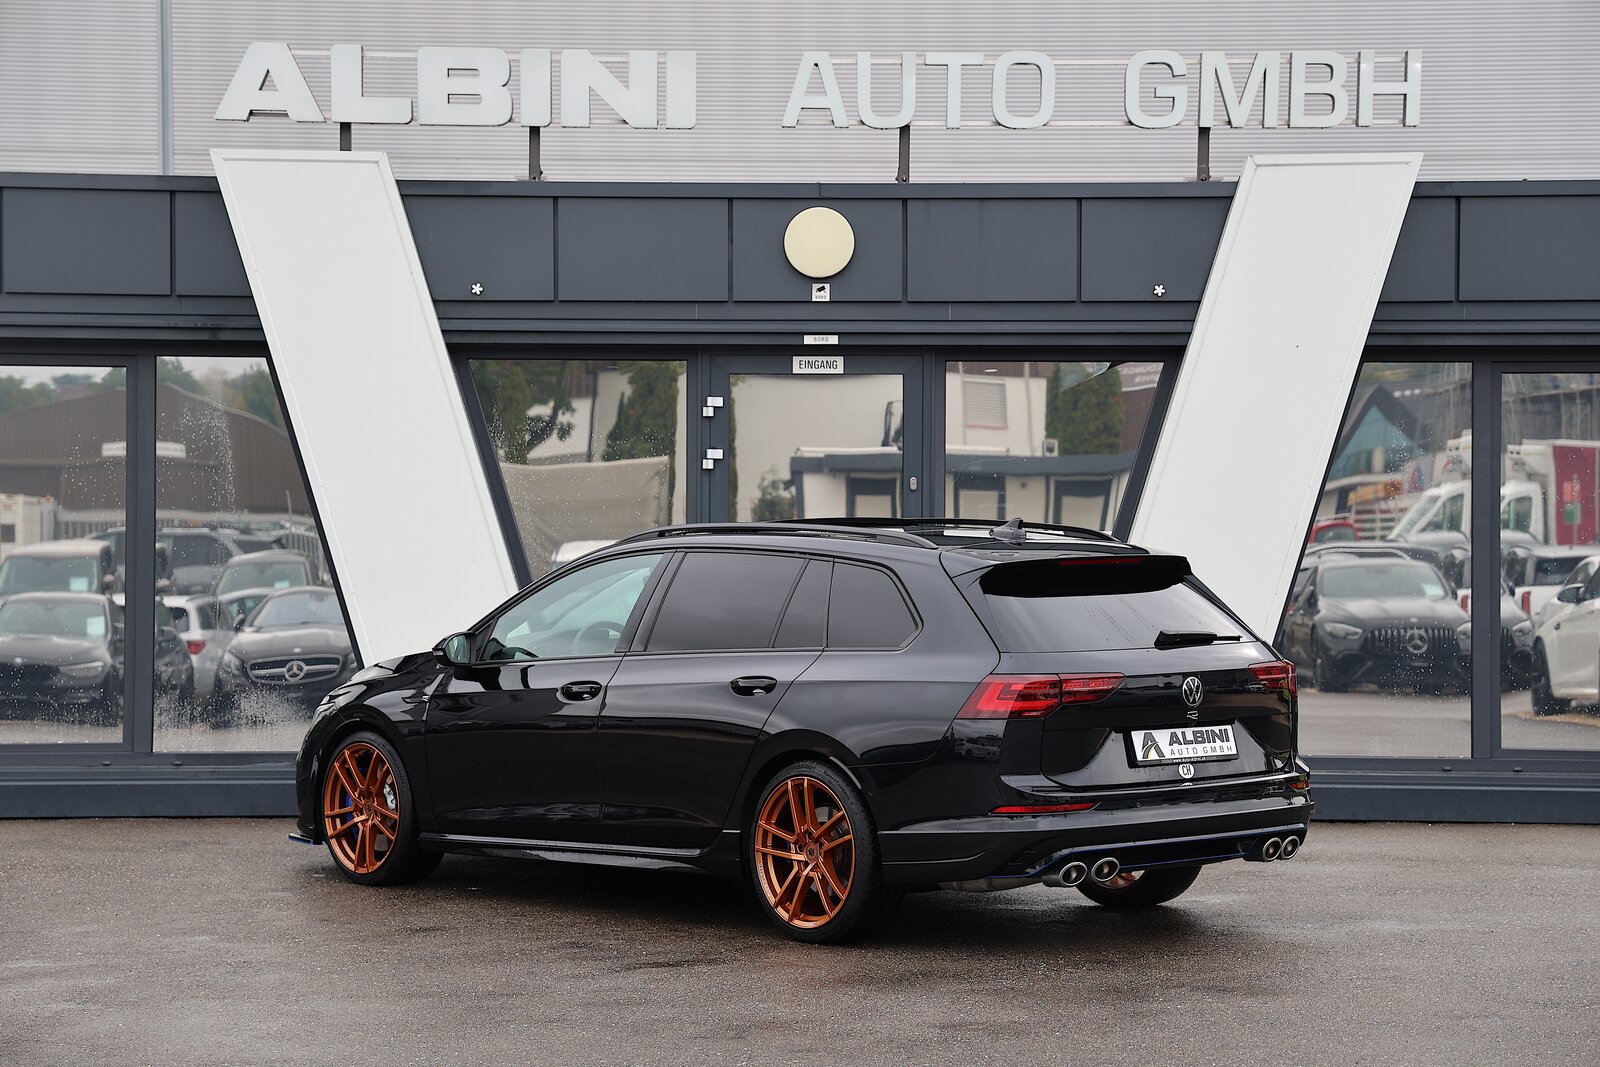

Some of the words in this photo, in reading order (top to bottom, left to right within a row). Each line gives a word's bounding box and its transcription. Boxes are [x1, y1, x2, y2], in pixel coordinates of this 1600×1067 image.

[214, 41, 697, 129] ALBINI
[781, 50, 1056, 129] AUTO
[1124, 49, 1423, 129] GMBH
[798, 359, 838, 370] EINGANG
[1168, 729, 1230, 746] ALBINI
[1170, 746, 1199, 757] AUTO
[1202, 745, 1233, 754] GMBH
[1181, 764, 1192, 776] CH
